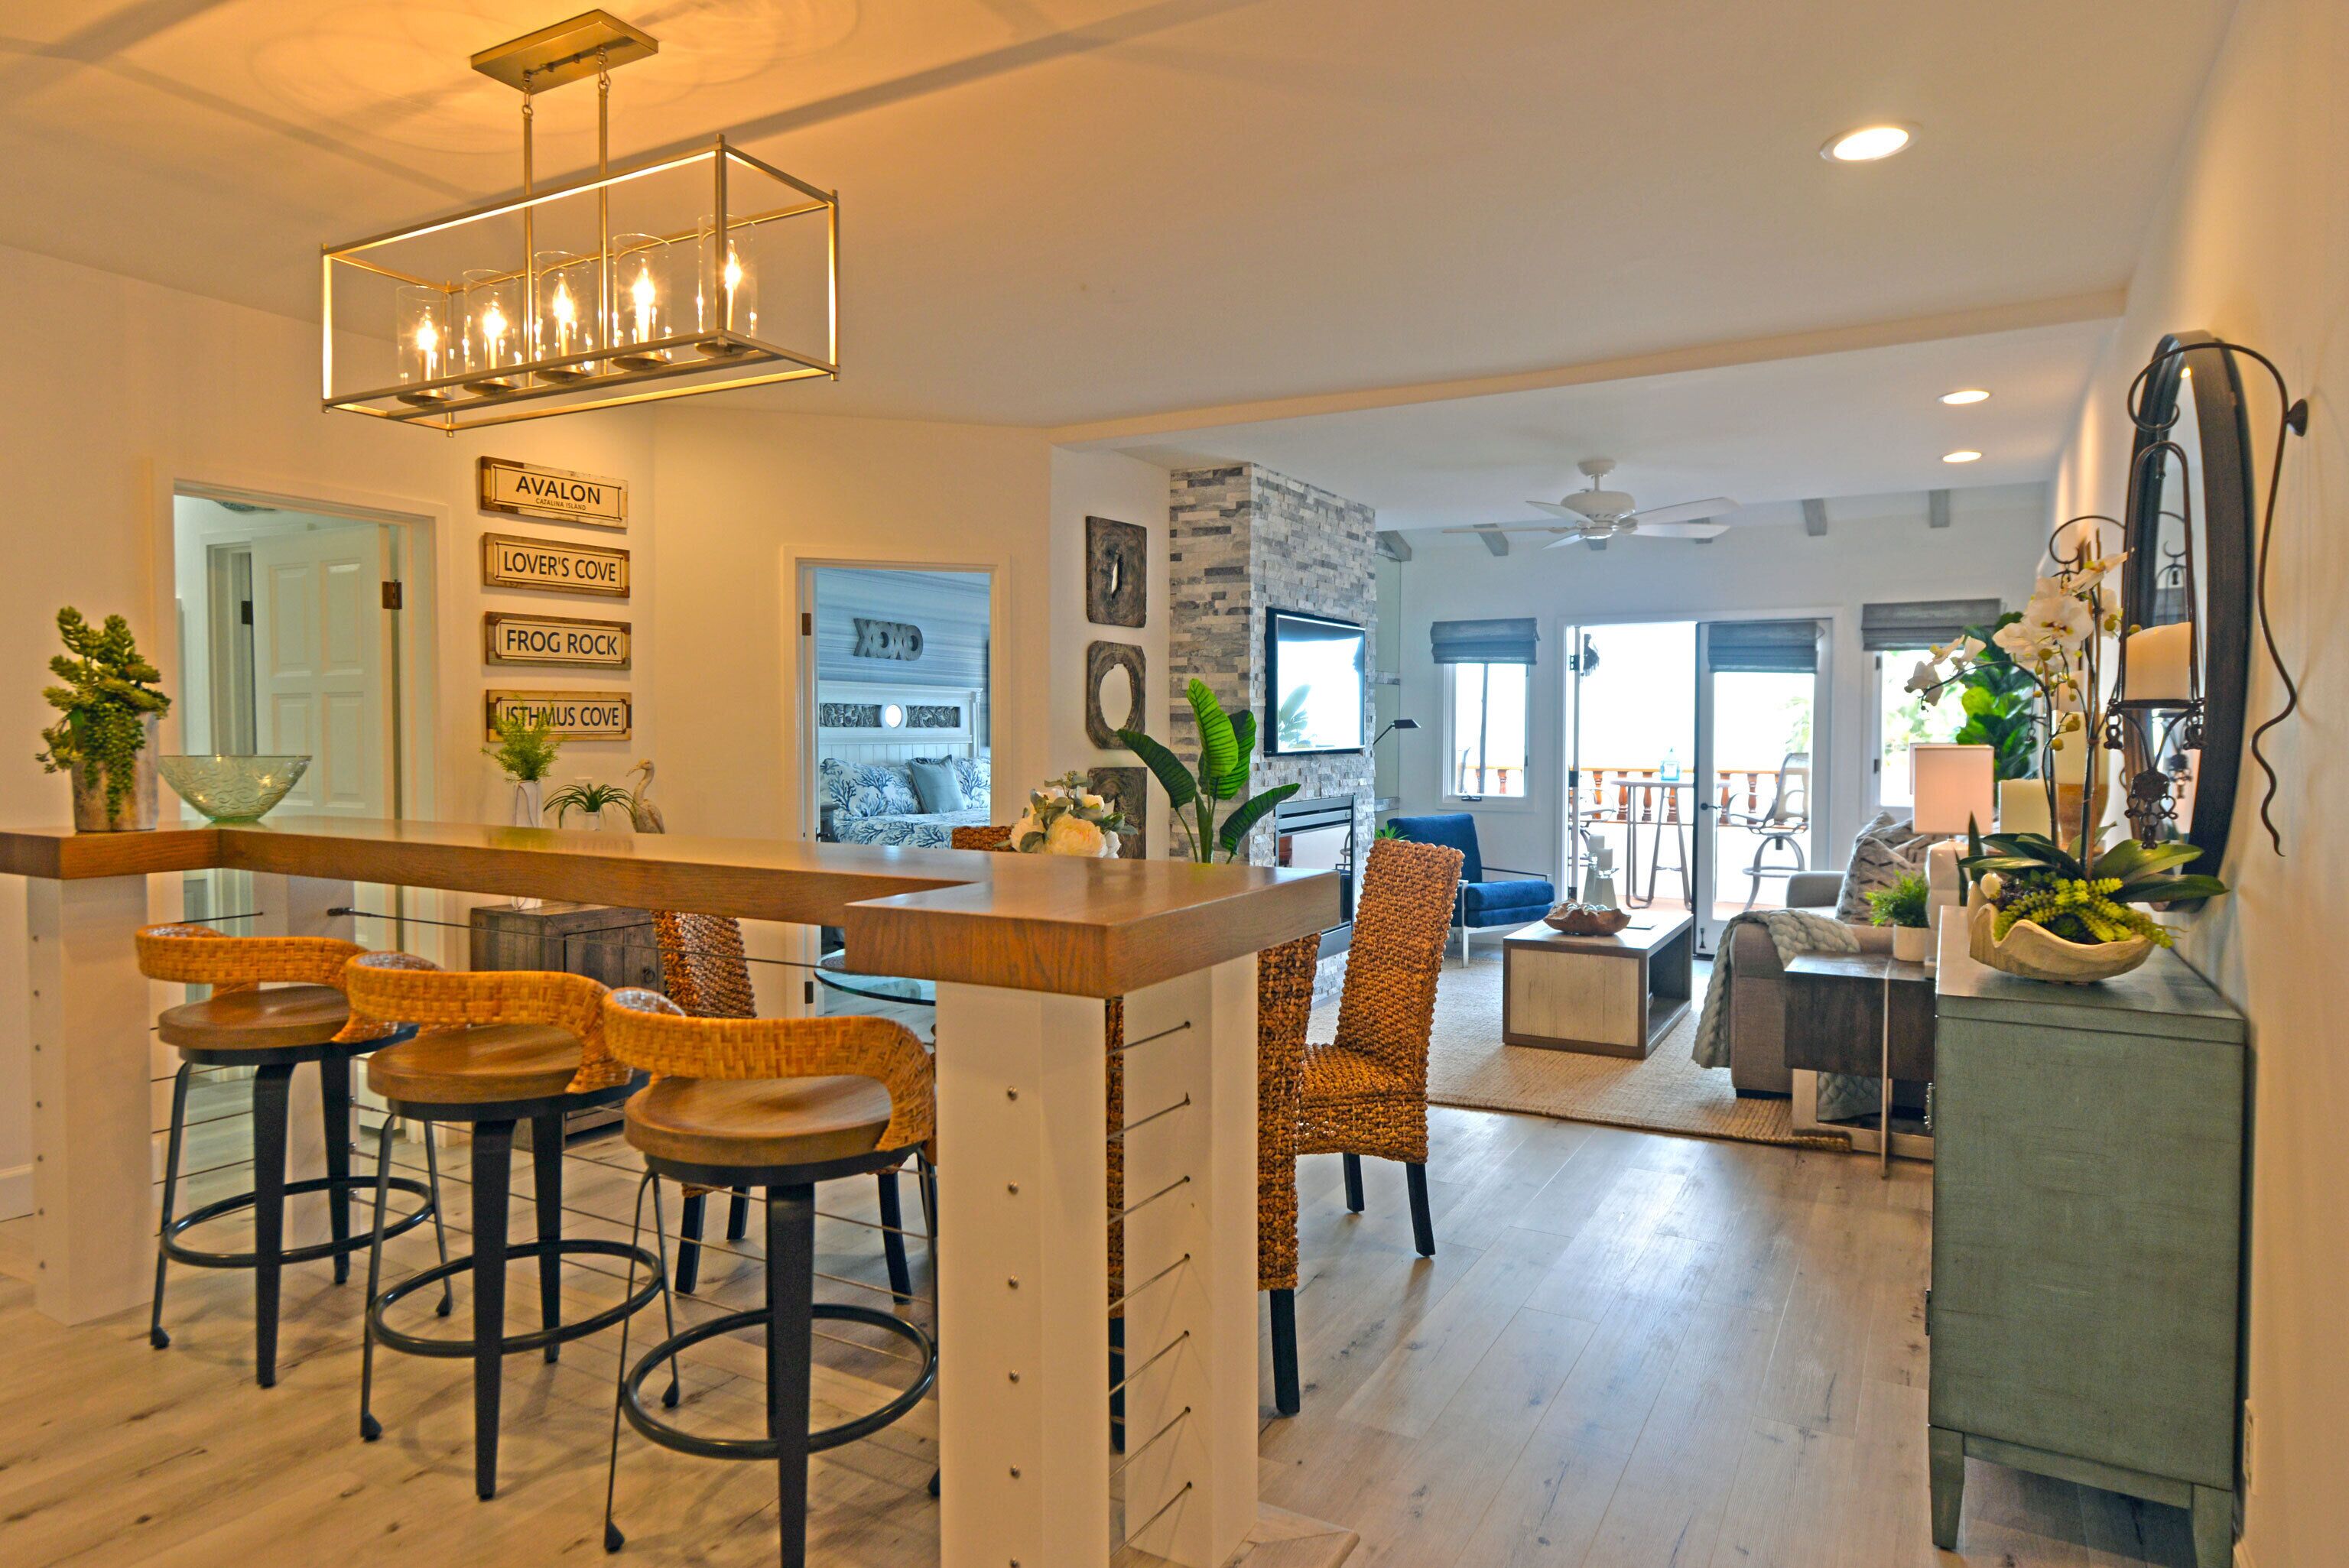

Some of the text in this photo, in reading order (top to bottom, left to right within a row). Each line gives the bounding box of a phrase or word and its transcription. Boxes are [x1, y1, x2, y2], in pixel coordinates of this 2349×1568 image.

[515, 476, 600, 505] AVALON
[535, 498, 564, 508] CATALINA
[504, 551, 616, 582] LOVER'S COVE
[506, 629, 617, 655] FROG ROCK
[853, 618, 924, 661] XOXO
[506, 706, 619, 727] ISTHMUS COVE
